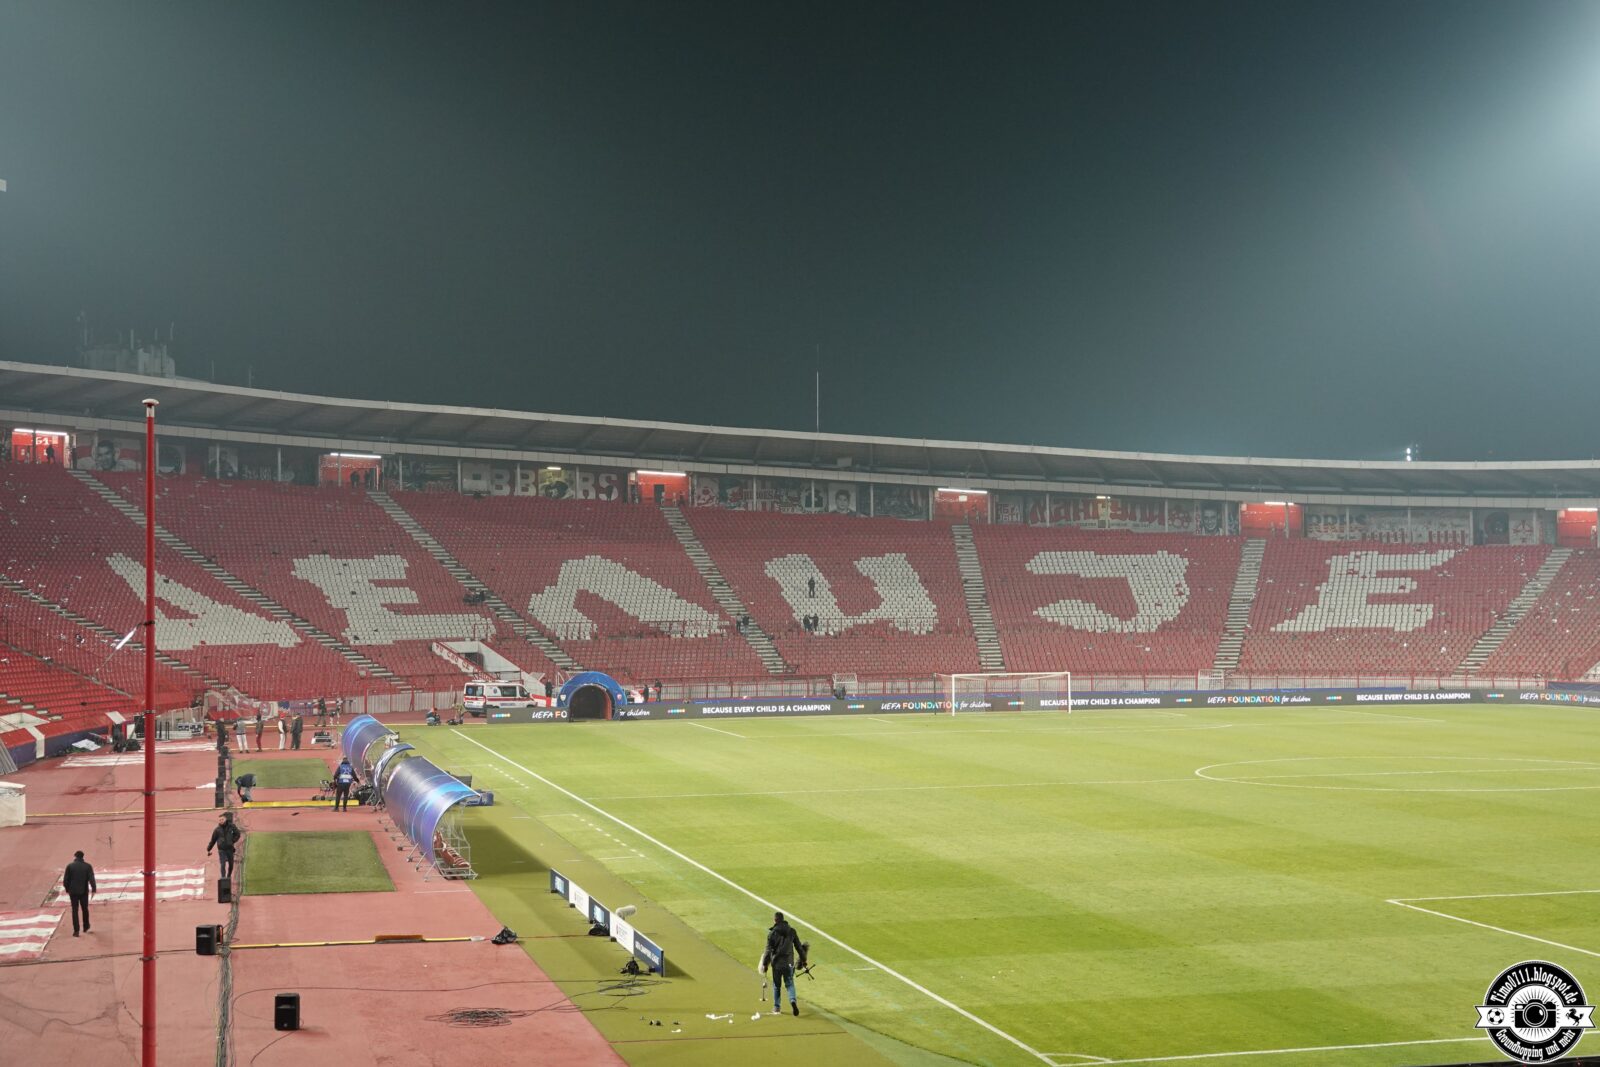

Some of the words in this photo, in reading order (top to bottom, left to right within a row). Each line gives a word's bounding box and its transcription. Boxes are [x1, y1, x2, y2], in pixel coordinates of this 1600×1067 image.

[1281, 696, 1289, 704] for
[1436, 692, 1471, 700] CHAMPION
[1520, 692, 1538, 700] UEFA
[881, 702, 901, 710] UEFA
[902, 701, 958, 710] FOUNDATION
[959, 702, 968, 710] for
[969, 701, 992, 709] children
[1069, 698, 1089, 706] EVERY
[1125, 697, 1160, 705] CHAMPION
[702, 706, 733, 714] BECAUSE
[756, 705, 777, 713] CHILD
[793, 704, 831, 712] CHAMPION
[532, 711, 553, 719] UEFA
[627, 709, 650, 717] children
